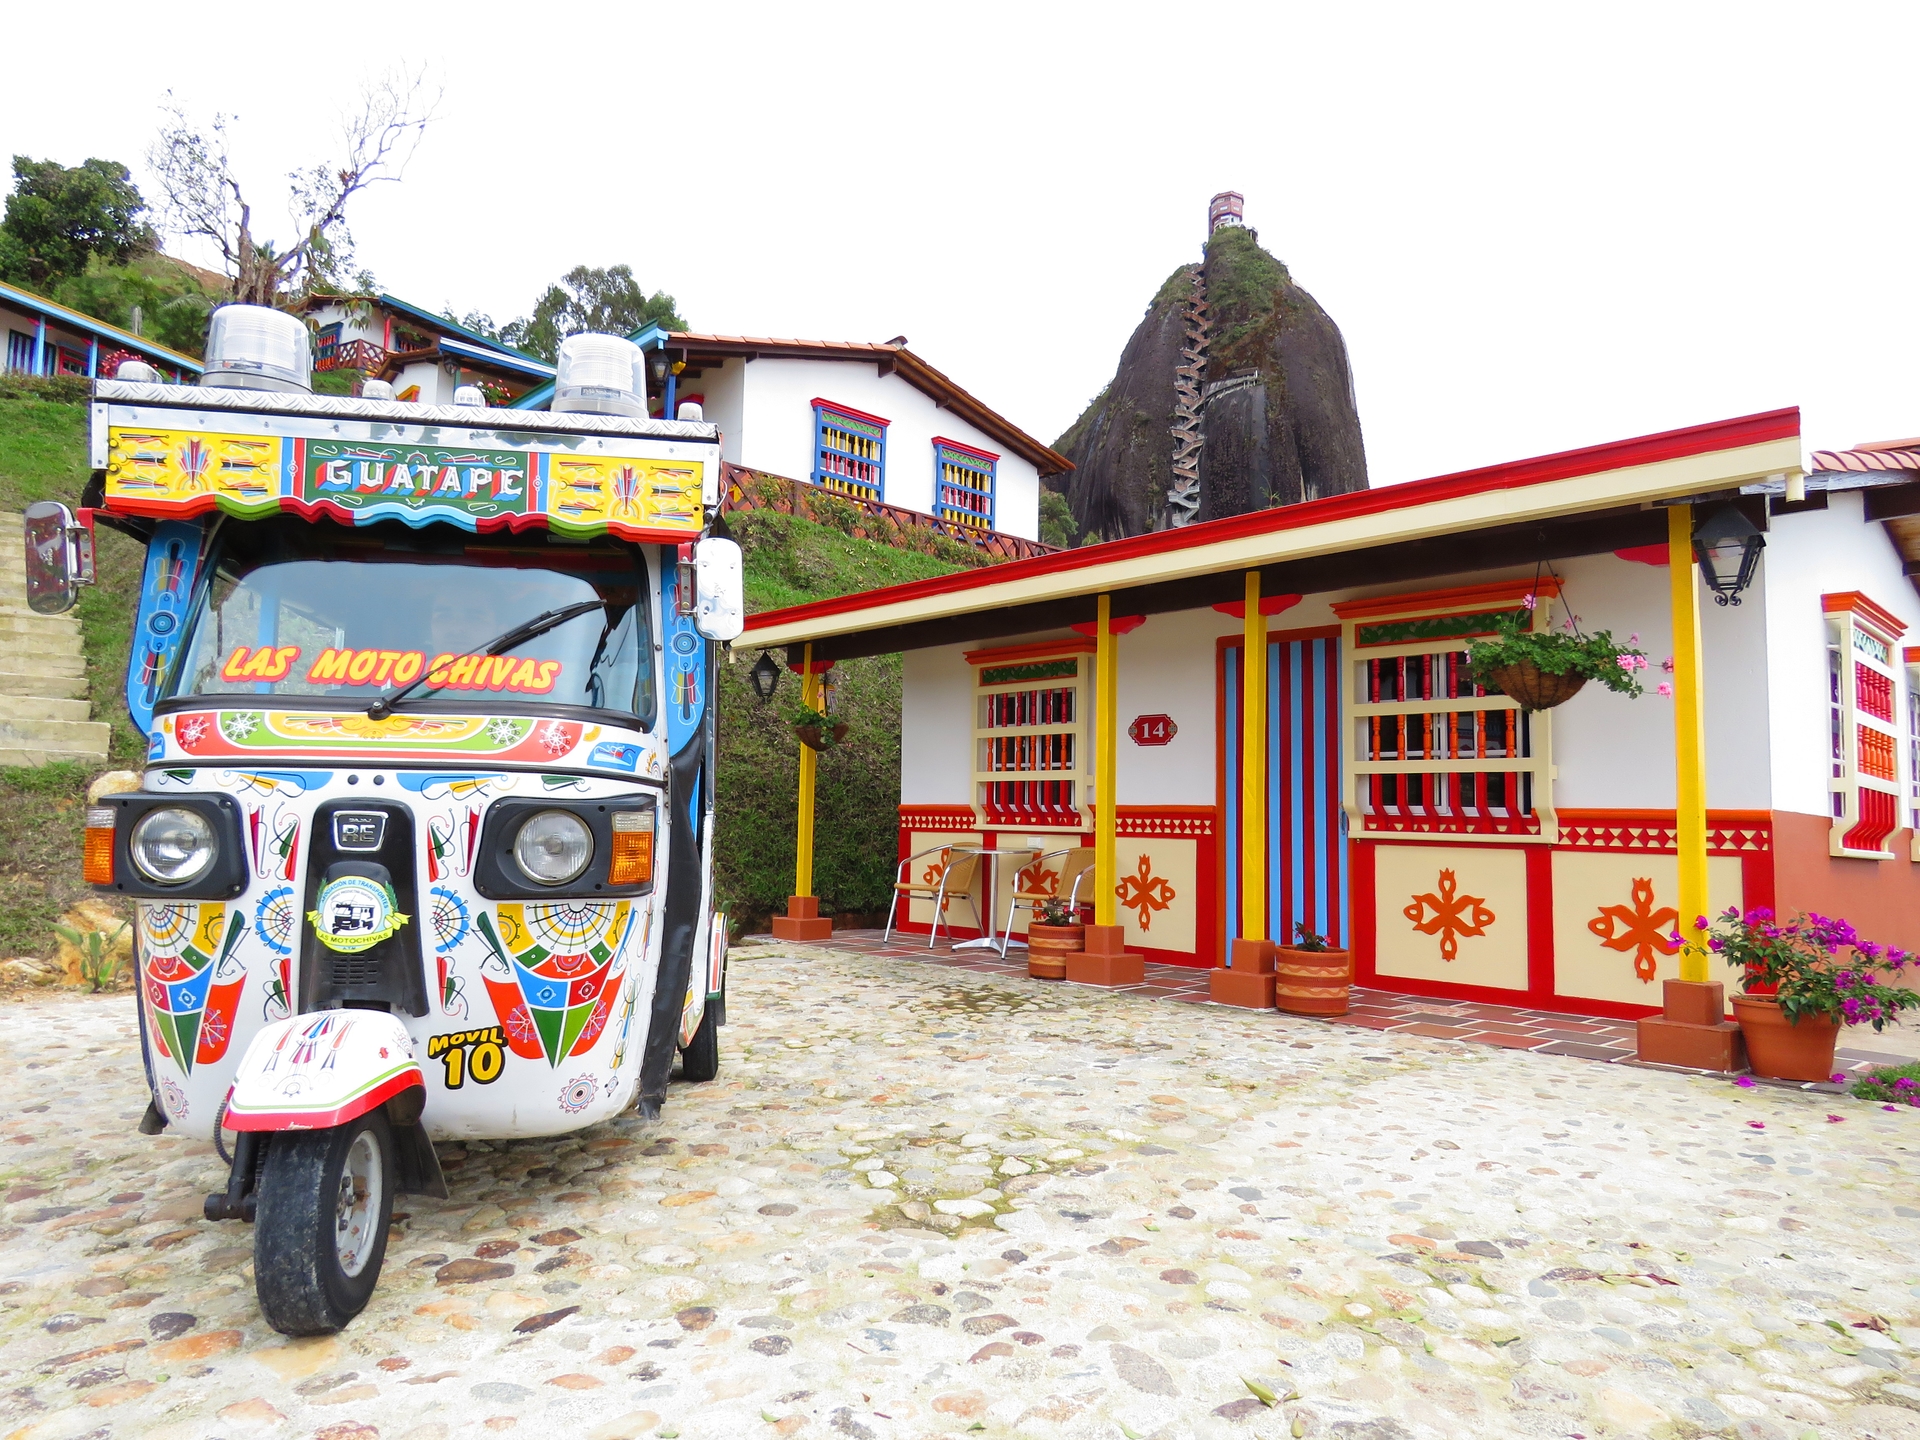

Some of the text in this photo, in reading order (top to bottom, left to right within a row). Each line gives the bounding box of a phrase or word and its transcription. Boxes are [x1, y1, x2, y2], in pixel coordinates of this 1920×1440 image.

[317, 459, 524, 499] GUATAPE
[221, 646, 562, 694] LAS MOTO CHIVAS
[1141, 721, 1165, 739] 14
[342, 824, 376, 842] RE
[358, 880, 389, 908] TRANSPORTES
[318, 931, 388, 944] LAS MOTOCHIVAS
[428, 1026, 506, 1057] MOVIL
[443, 1042, 504, 1088] 10
